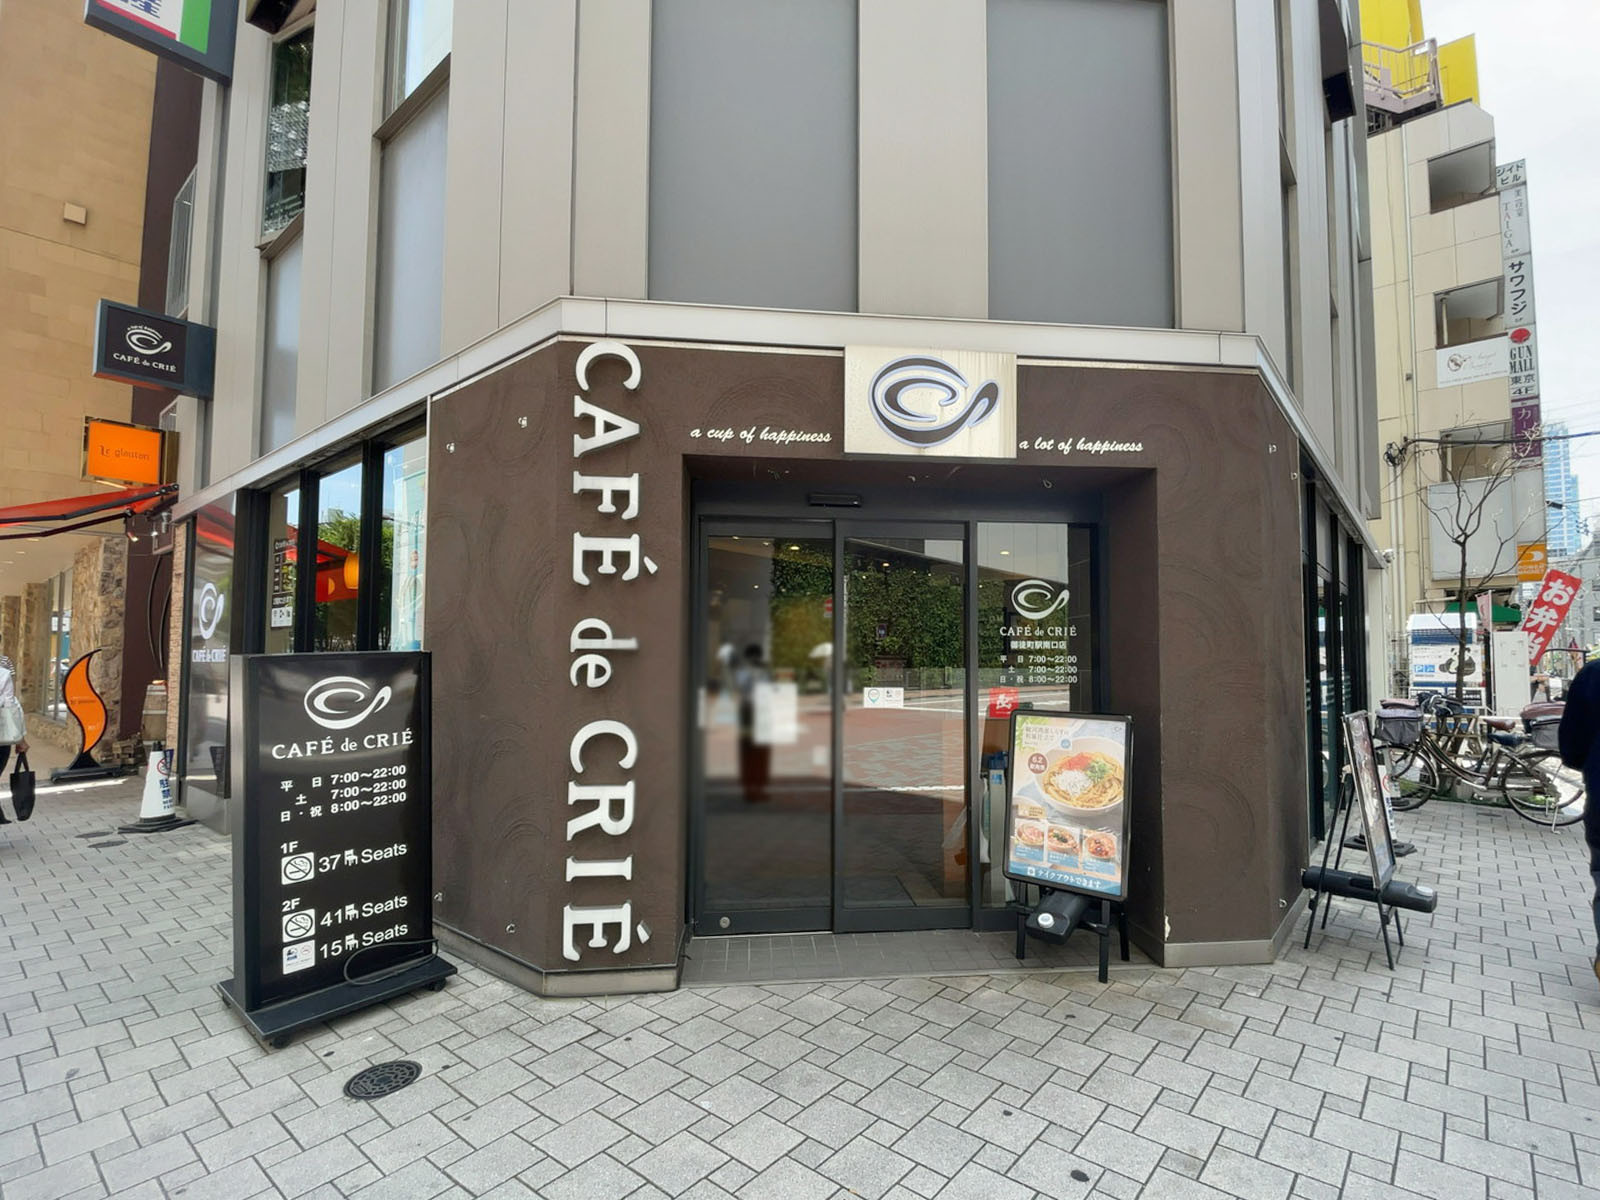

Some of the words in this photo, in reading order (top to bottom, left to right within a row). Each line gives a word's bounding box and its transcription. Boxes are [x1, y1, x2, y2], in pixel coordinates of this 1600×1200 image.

[1508, 260, 1527, 316] サワフジ
[1509, 344, 1534, 361] GUN
[113, 352, 141, 365] CAFÉ
[152, 361, 177, 373] CRIÉ
[1509, 358, 1535, 374] MALL
[1511, 373, 1535, 385] 東京
[1511, 386, 1535, 396] 4F
[690, 428, 702, 438] a
[707, 427, 735, 442] cup
[739, 426, 756, 443] of
[760, 426, 832, 444] happiness
[1019, 440, 1029, 450] a
[1034, 436, 1054, 450] lot
[1057, 438, 1073, 455] of
[1076, 437, 1144, 454] happiness
[573, 340, 658, 586] CAFÉ
[1000, 624, 1032, 636] CAFÉ
[1034, 626, 1045, 636] de
[1047, 624, 1077, 636] CRIÉ
[570, 617, 639, 689] de
[1008, 665, 1016, 673] 土
[271, 736, 335, 760] CAFÉ
[341, 737, 357, 752] de
[363, 728, 414, 749] CRIÉ
[295, 794, 308, 805] 土
[280, 841, 299, 854] 1F
[562, 719, 651, 962] CRIÉ
[318, 854, 341, 873] 37
[361, 842, 408, 864] Seats
[281, 897, 301, 912] 2F
[320, 909, 342, 927] 41
[361, 895, 408, 918] Seats
[320, 940, 342, 959] 15
[361, 923, 409, 947] Seats
